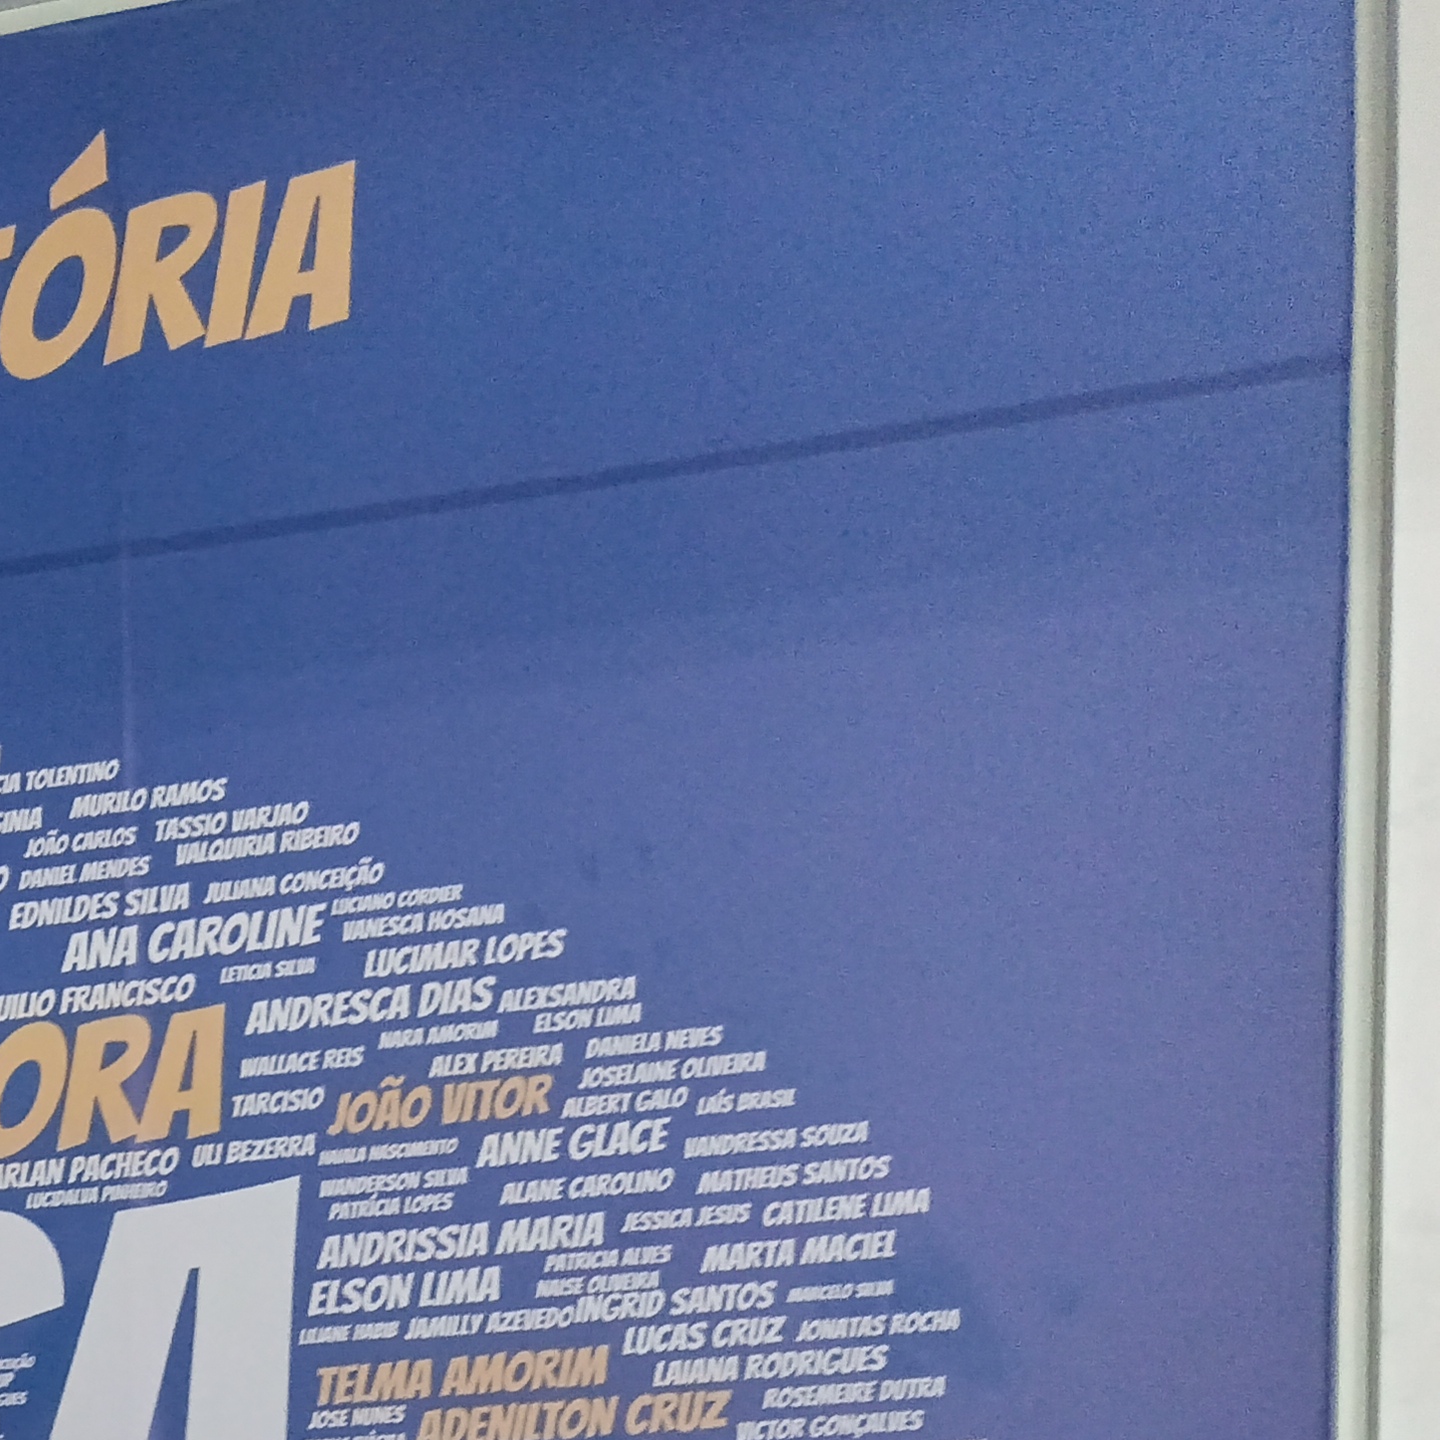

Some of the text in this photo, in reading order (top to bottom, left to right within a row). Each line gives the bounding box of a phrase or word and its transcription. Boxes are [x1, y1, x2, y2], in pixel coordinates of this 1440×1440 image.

[61, 903, 327, 972] ANA CAROLINE
[245, 976, 496, 1035] ANDRESCA DIAS
[327, 1074, 553, 1135] JOÃO VITOR
[476, 1117, 671, 1168] ANNE GLACE
[317, 1212, 604, 1269] ANDRISSIA MARIA
[700, 1230, 896, 1273] MARTA MACIEL
[308, 1266, 500, 1316] ELSON LIMA
[317, 1345, 609, 1406] TELMA AMORIM
[625, 1390, 732, 1435] CRUZ
